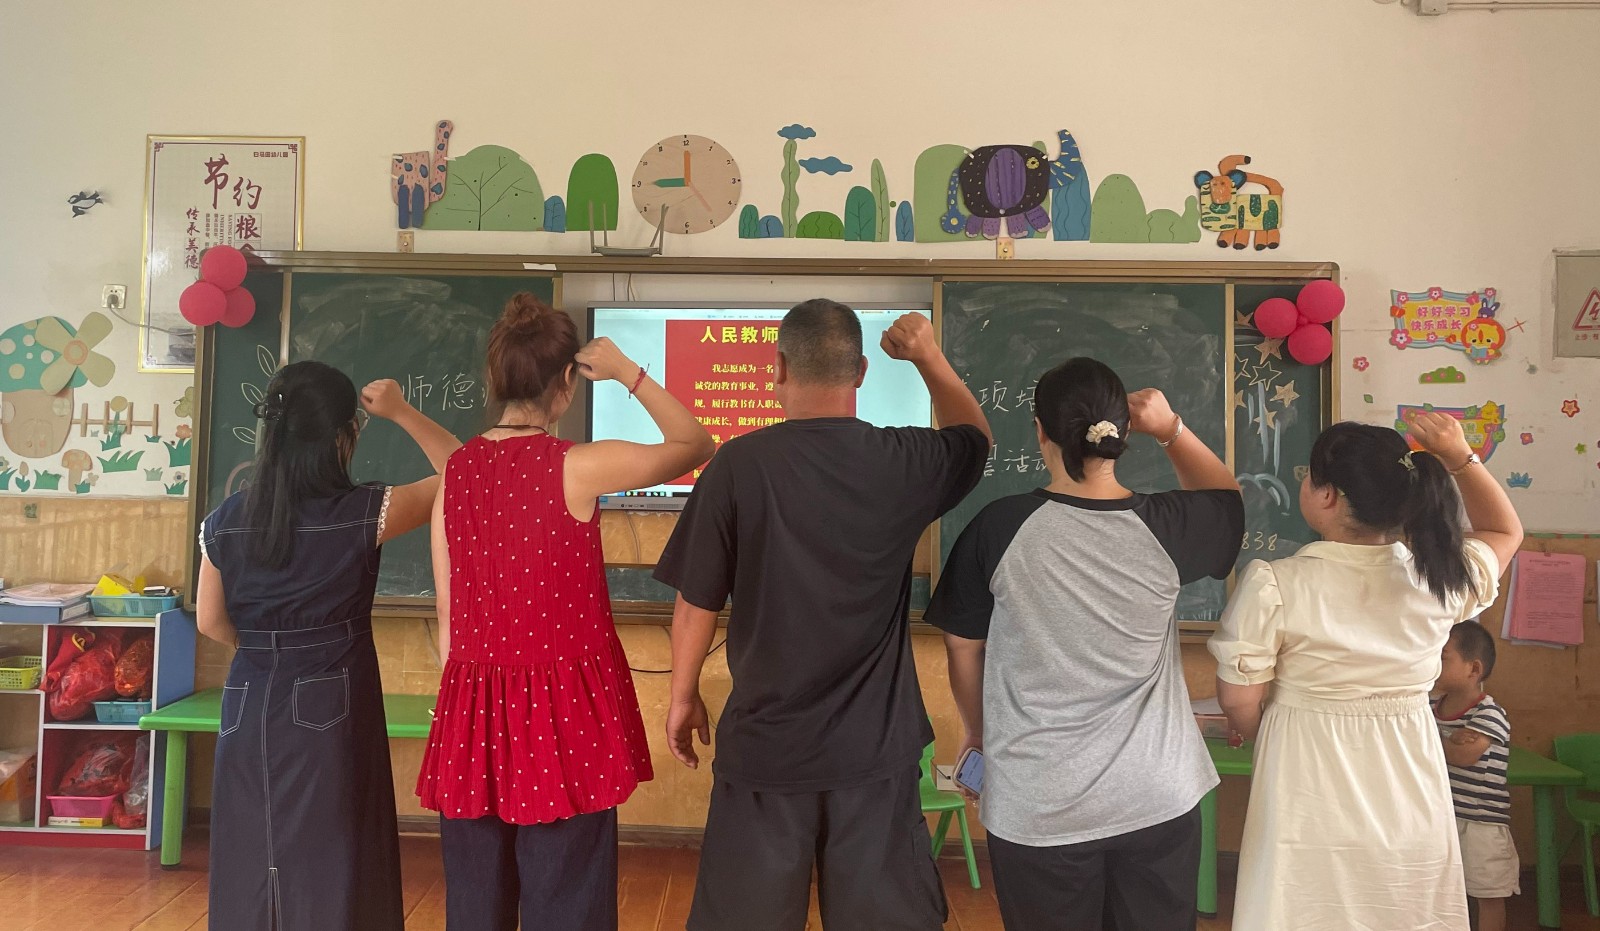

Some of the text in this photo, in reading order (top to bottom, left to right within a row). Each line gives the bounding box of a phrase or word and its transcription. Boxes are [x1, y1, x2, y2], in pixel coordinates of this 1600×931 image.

[204, 153, 262, 210] 节约
[185, 206, 200, 269] 传承美德
[1417, 306, 1471, 318] 好好学习
[700, 325, 779, 344] 人民教师
[1411, 319, 1462, 331] 快乐成长
[712, 363, 774, 374] 我志愿成为一名
[402, 372, 489, 411] 师德
[1241, 531, 1278, 551] 838
